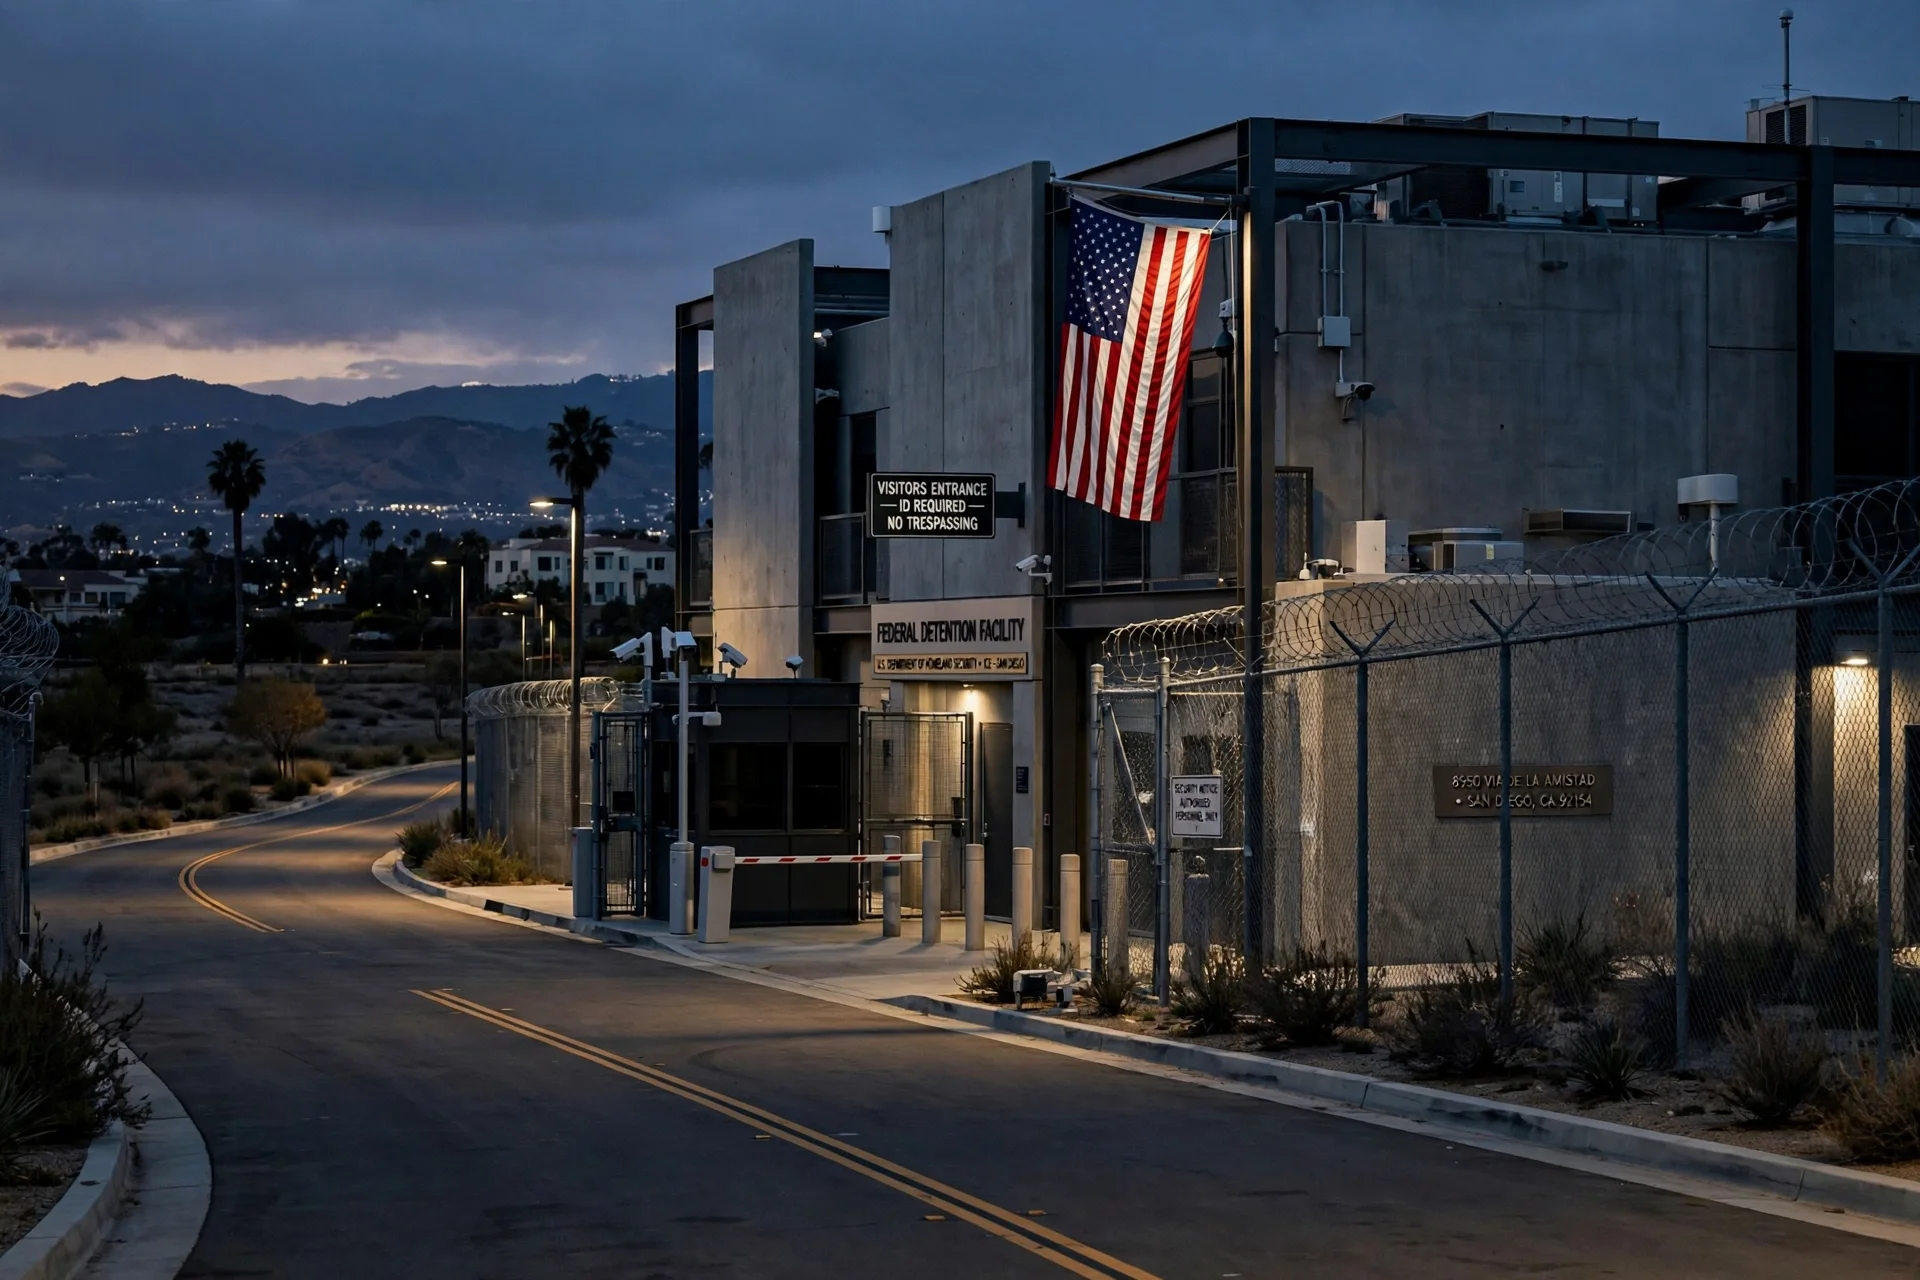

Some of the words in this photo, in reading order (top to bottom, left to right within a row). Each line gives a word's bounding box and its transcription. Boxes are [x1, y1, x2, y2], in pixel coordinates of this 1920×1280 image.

[877, 481, 927, 495] VISITORS
[931, 482, 987, 496] ENTRANCE
[899, 499, 910, 513] ID
[914, 499, 966, 513] REQUIRED
[887, 516, 903, 530] NO
[907, 516, 978, 530] TRESPASSING
[877, 622, 919, 643] FEDERAL
[921, 620, 976, 642] DETENTION
[979, 618, 1025, 641] FACILITY
[1452, 775, 1481, 788] 8950
[1484, 775, 1503, 787] VIA
[1526, 774, 1539, 787] LA
[1544, 773, 1595, 787] AMISTAD
[1467, 793, 1490, 808] SAN
[1495, 794, 1535, 809] DEGO,
[1540, 794, 1556, 808] CA
[1560, 793, 1592, 808] 92154
